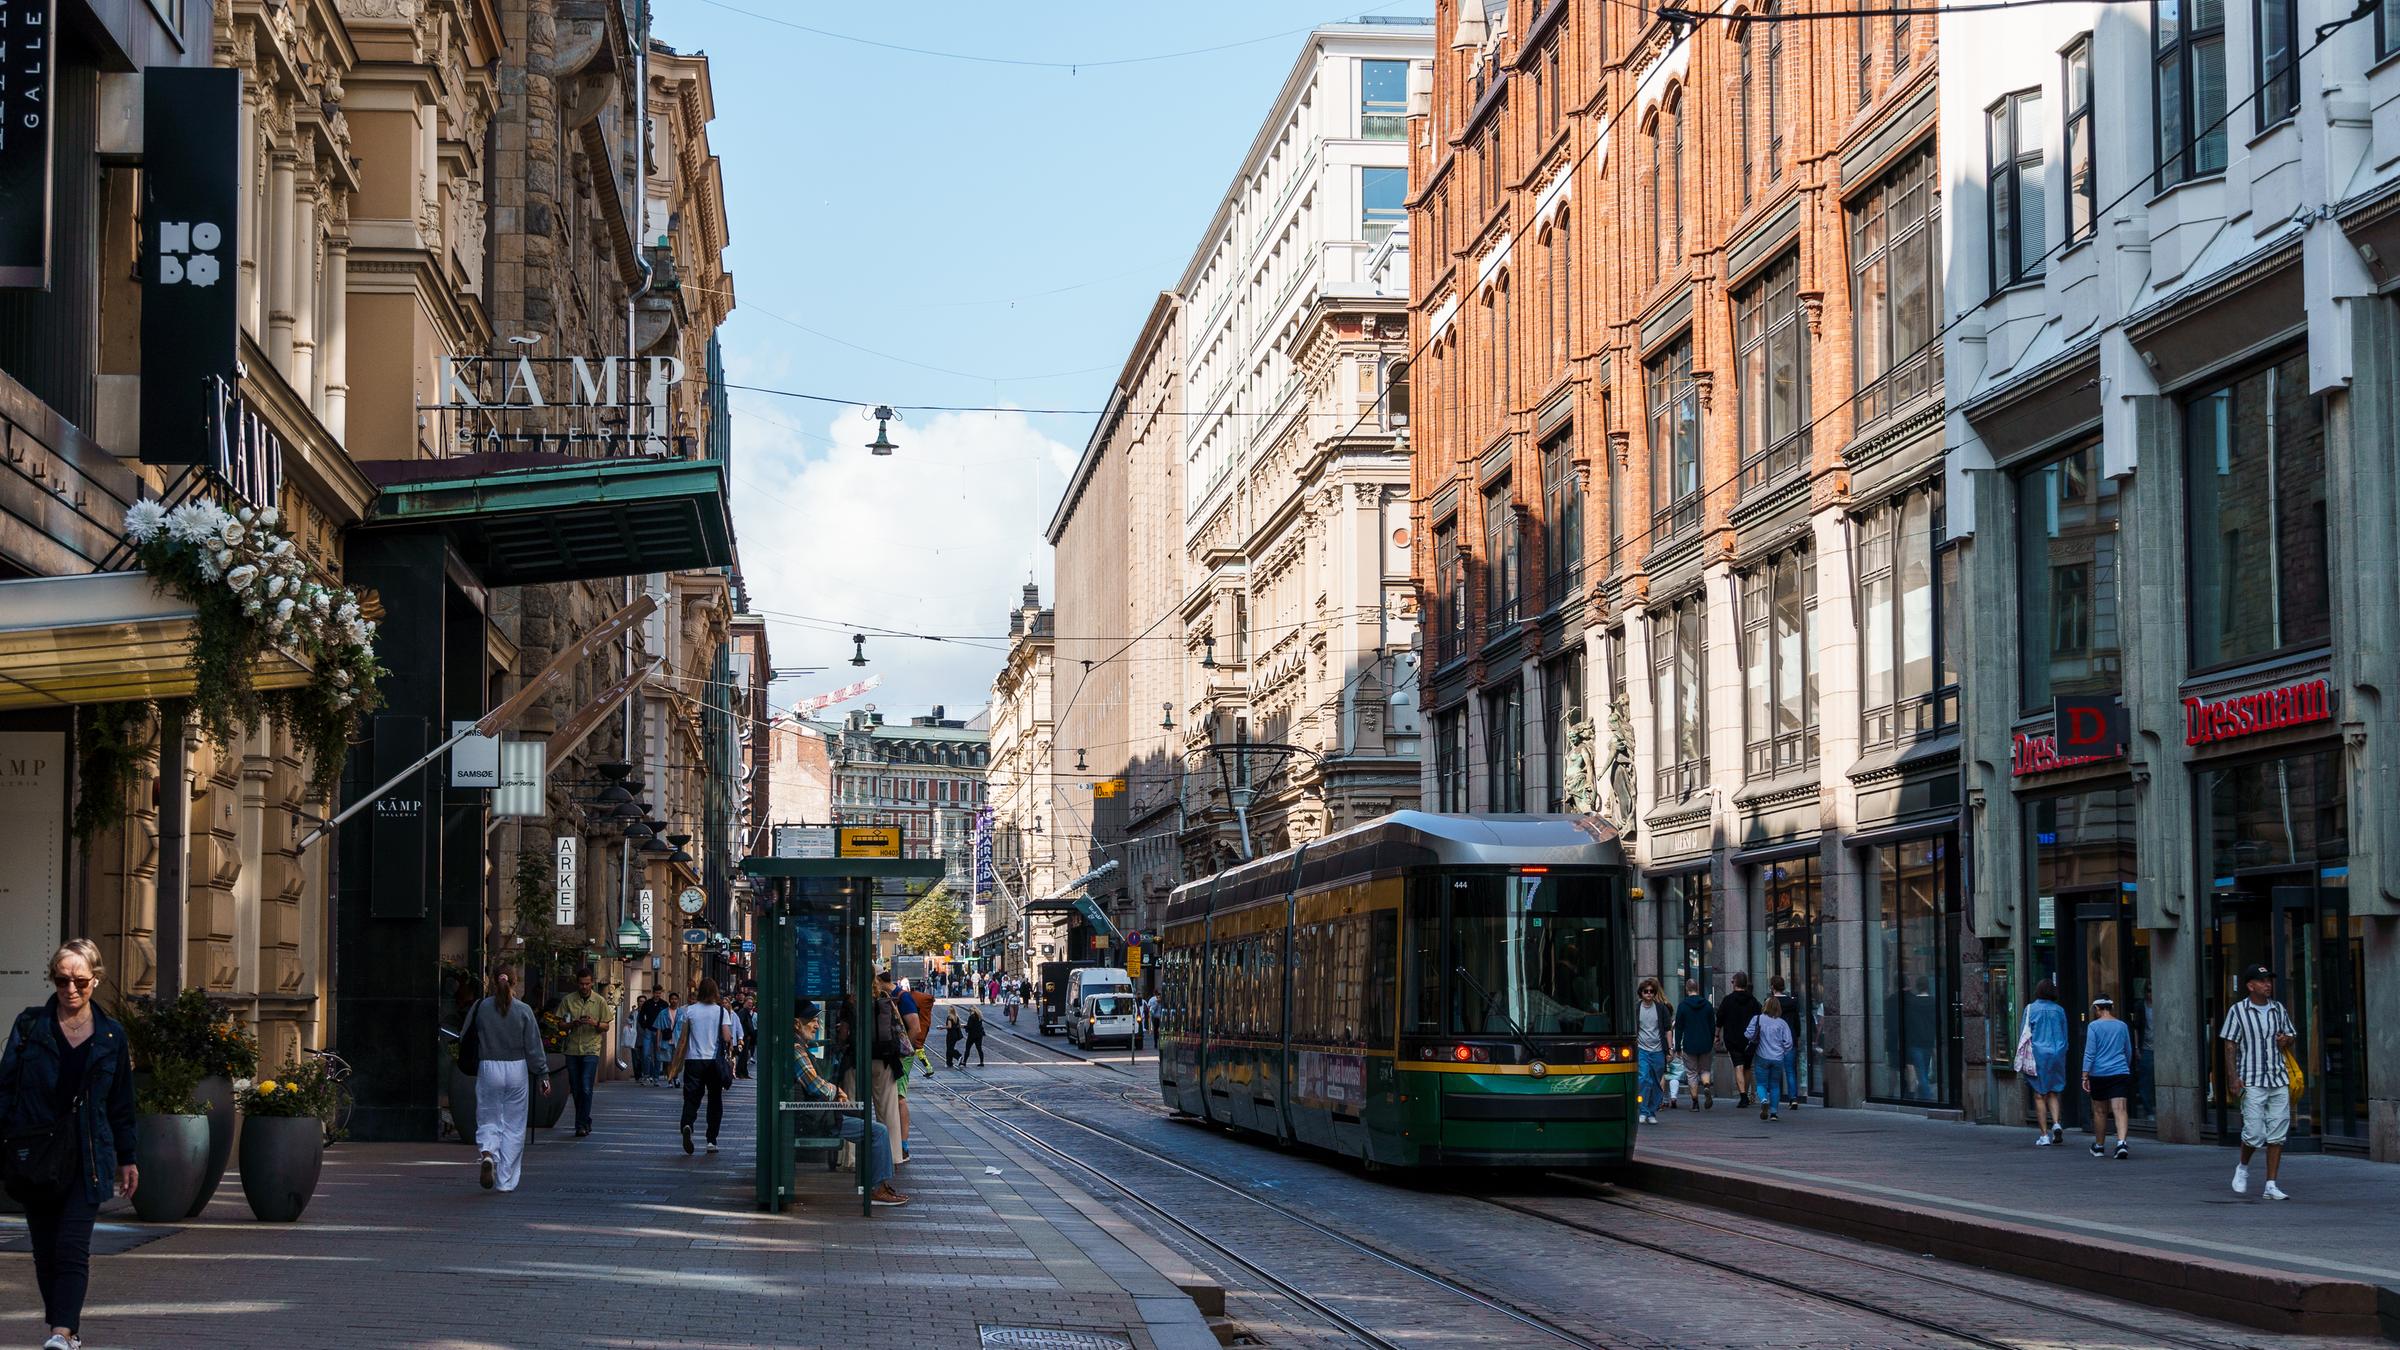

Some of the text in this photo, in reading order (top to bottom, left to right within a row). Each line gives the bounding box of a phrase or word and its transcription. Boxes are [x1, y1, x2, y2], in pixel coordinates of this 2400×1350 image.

[457, 427, 665, 443] GALLERIA
[2066, 707, 2107, 745] D
[2184, 679, 2329, 747] Dressmann
[457, 770, 494, 778] SAMSØE
[560, 839, 573, 924] ARKET
[1454, 881, 1468, 889] 444
[1521, 876, 1542, 910] 7
